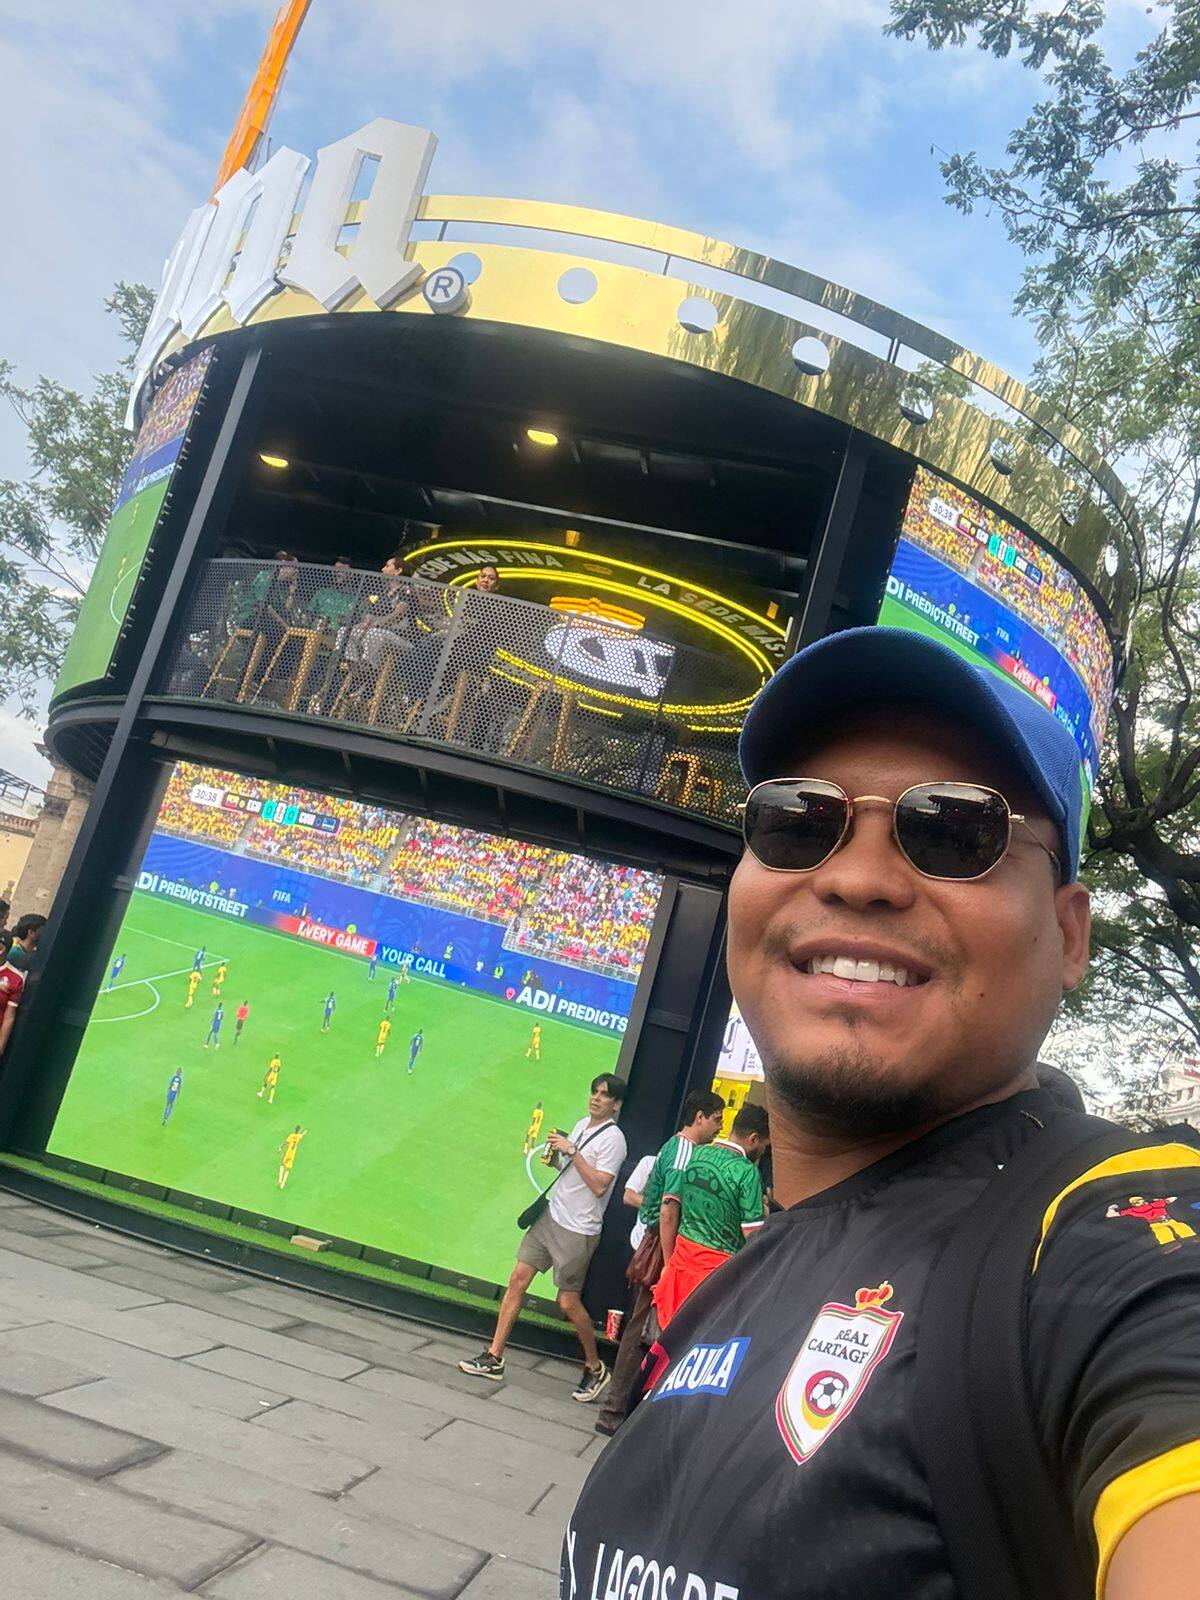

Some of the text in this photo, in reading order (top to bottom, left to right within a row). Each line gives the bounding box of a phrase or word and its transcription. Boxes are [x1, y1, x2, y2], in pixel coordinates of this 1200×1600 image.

[932, 502, 954, 522] 30:38
[497, 550, 564, 568] FINA
[638, 576, 671, 596] LA
[678, 592, 746, 624] SEDE
[905, 588, 981, 647] PREDICTSTREET
[996, 627, 1011, 643] FIFA
[194, 788, 218, 803] 30:38
[136, 871, 249, 918] DI PREDICTSTREET
[272, 889, 291, 904] FIFA
[335, 933, 369, 955] GAME
[382, 945, 446, 979] YOUR CALL
[556, 999, 629, 1033] PREDICTS
[835, 1329, 870, 1347] REAL
[592, 1543, 677, 1600] LAGOS
